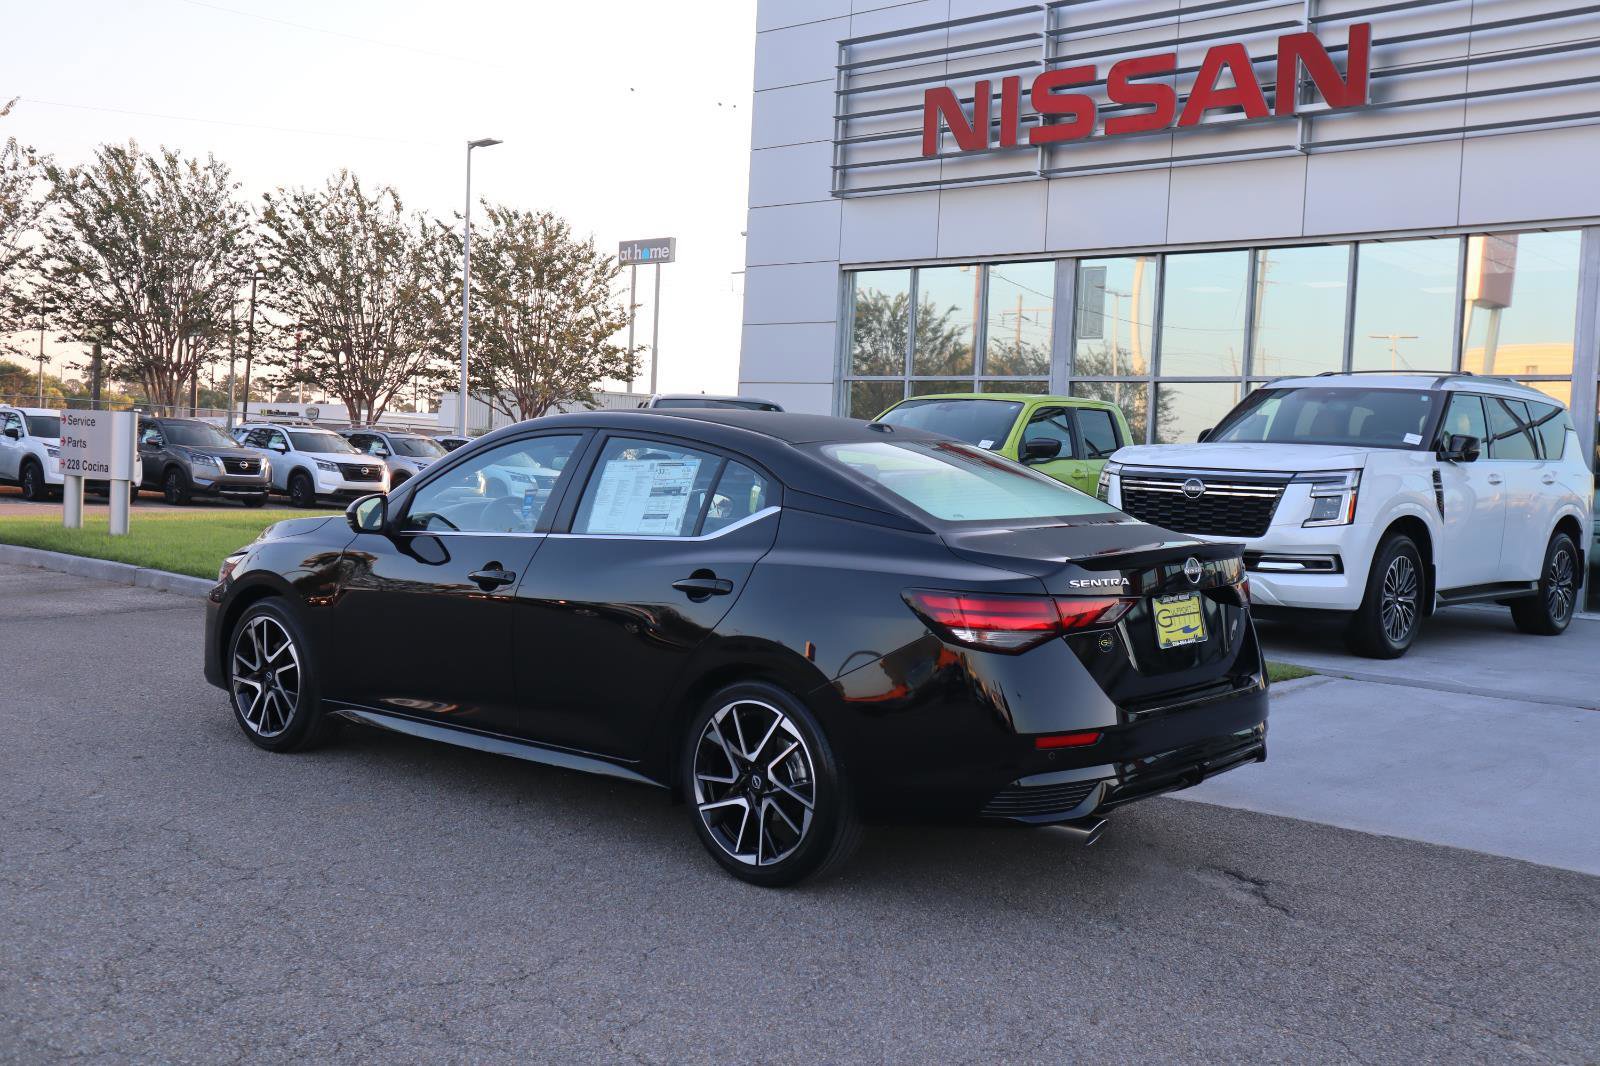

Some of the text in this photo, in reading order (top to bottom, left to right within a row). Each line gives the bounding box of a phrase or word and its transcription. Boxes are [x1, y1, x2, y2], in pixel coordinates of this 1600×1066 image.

[921, 22, 1371, 158] NISSAN
[620, 243, 670, 261] at home
[67, 415, 96, 427] Service
[67, 437, 87, 449] Parts
[67, 459, 109, 473] 228 Cocina
[1069, 577, 1130, 588] SENTRA
